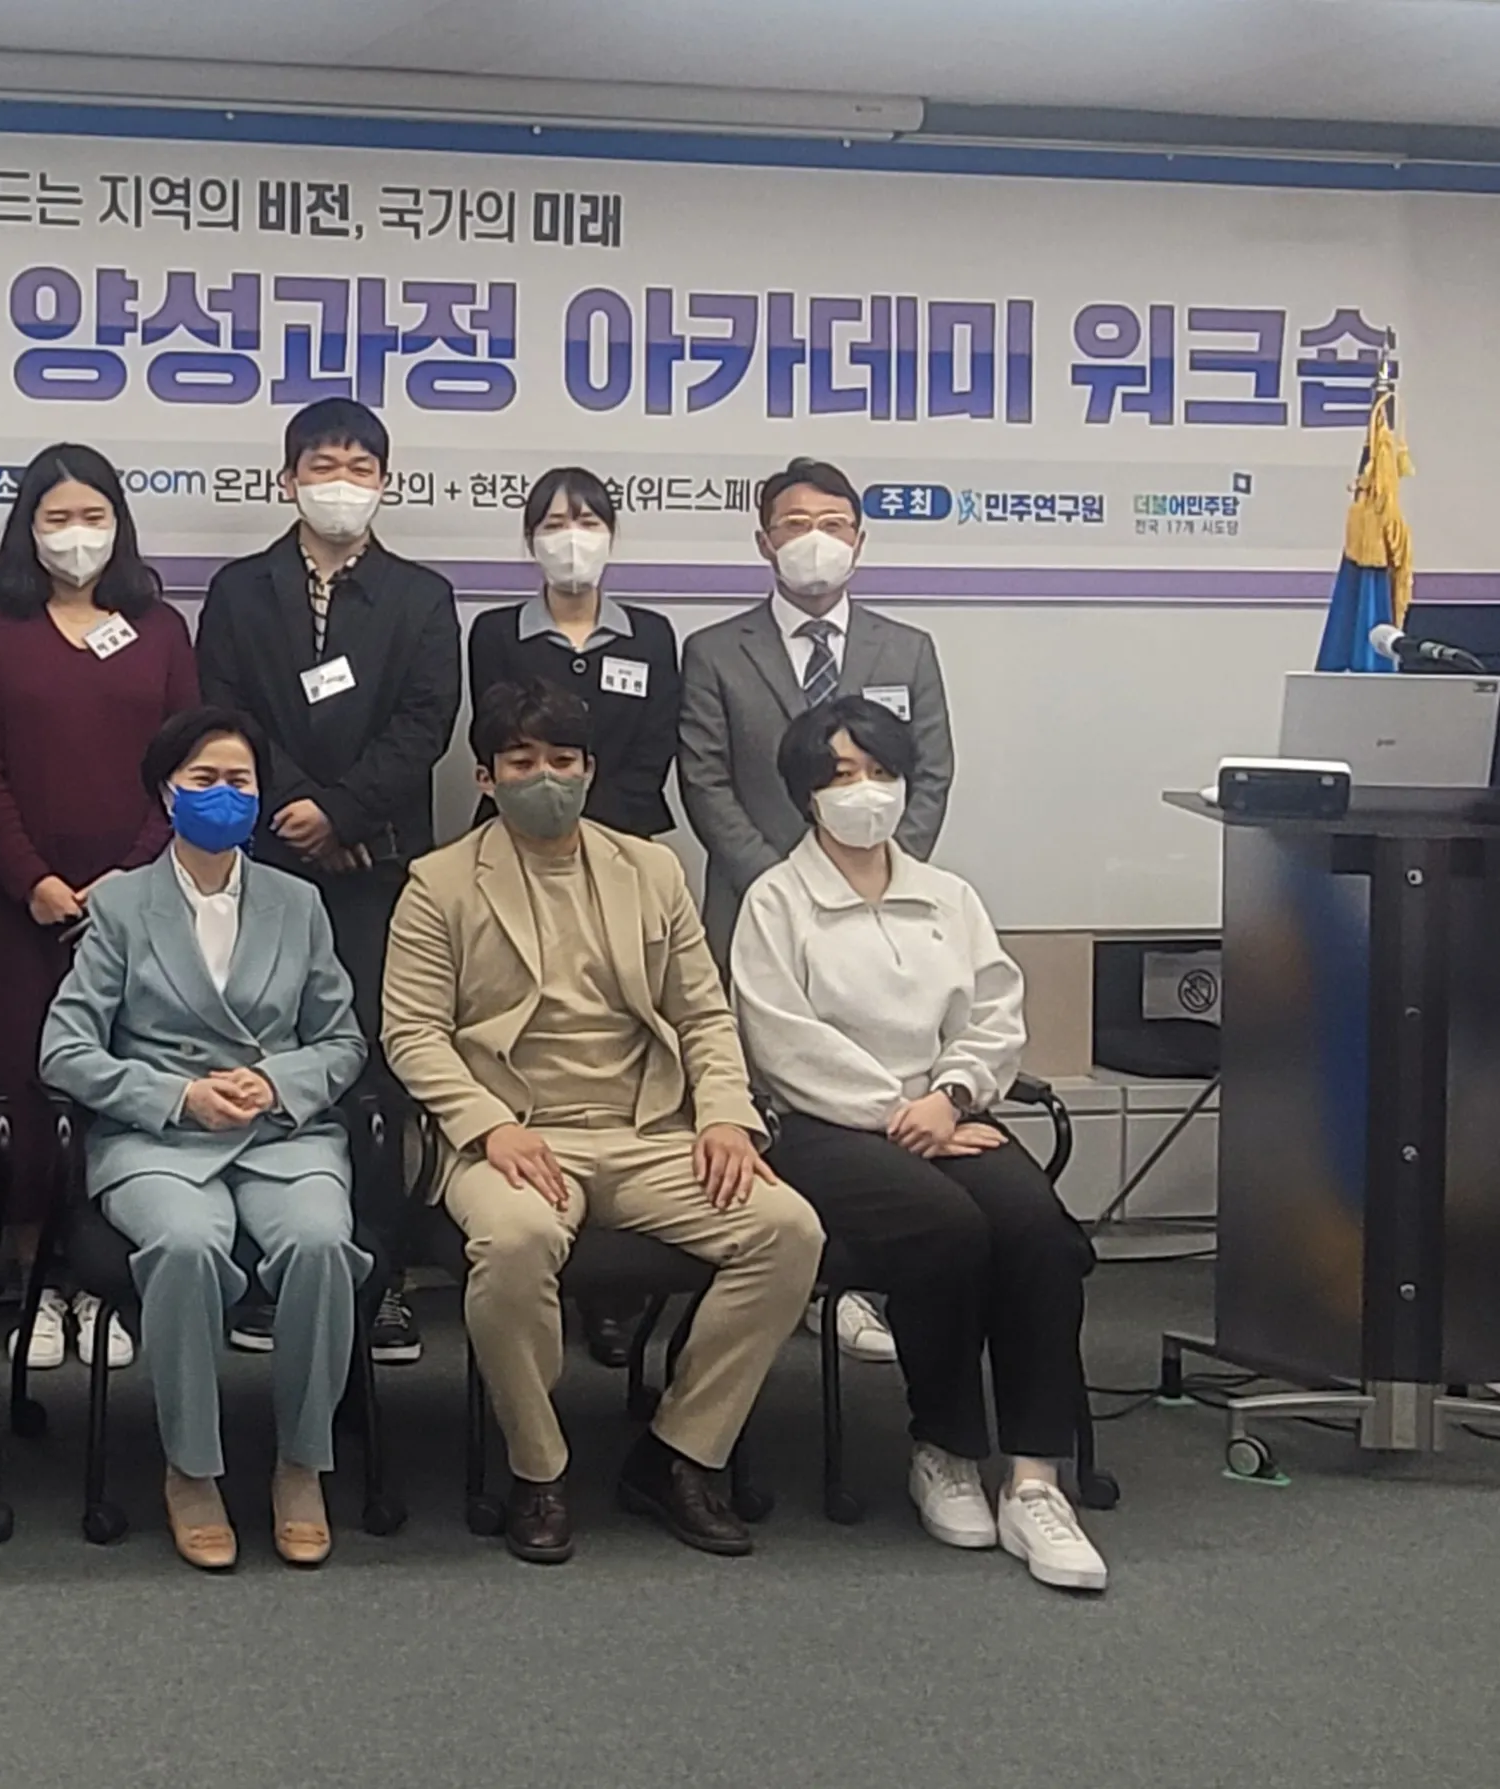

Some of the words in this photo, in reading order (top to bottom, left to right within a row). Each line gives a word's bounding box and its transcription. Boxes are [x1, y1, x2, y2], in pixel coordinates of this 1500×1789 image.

[98, 174, 240, 232] 지역의
[258, 180, 364, 241] 비전,
[378, 186, 516, 244] 국가의
[533, 192, 622, 248] 미래
[9, 265, 518, 411] 양성과정
[564, 286, 1034, 424] 아카데미
[1070, 304, 1399, 430] 워크숍
[212, 468, 295, 503] 온라
[380, 472, 434, 507] 강의
[470, 472, 529, 509] 현장
[880, 488, 933, 516] 주최
[985, 493, 1105, 523] 민주연구원
[1133, 494, 1241, 517] 더불어민주당
[1166, 519, 1195, 535] 17개
[1201, 519, 1239, 537] 시도당
